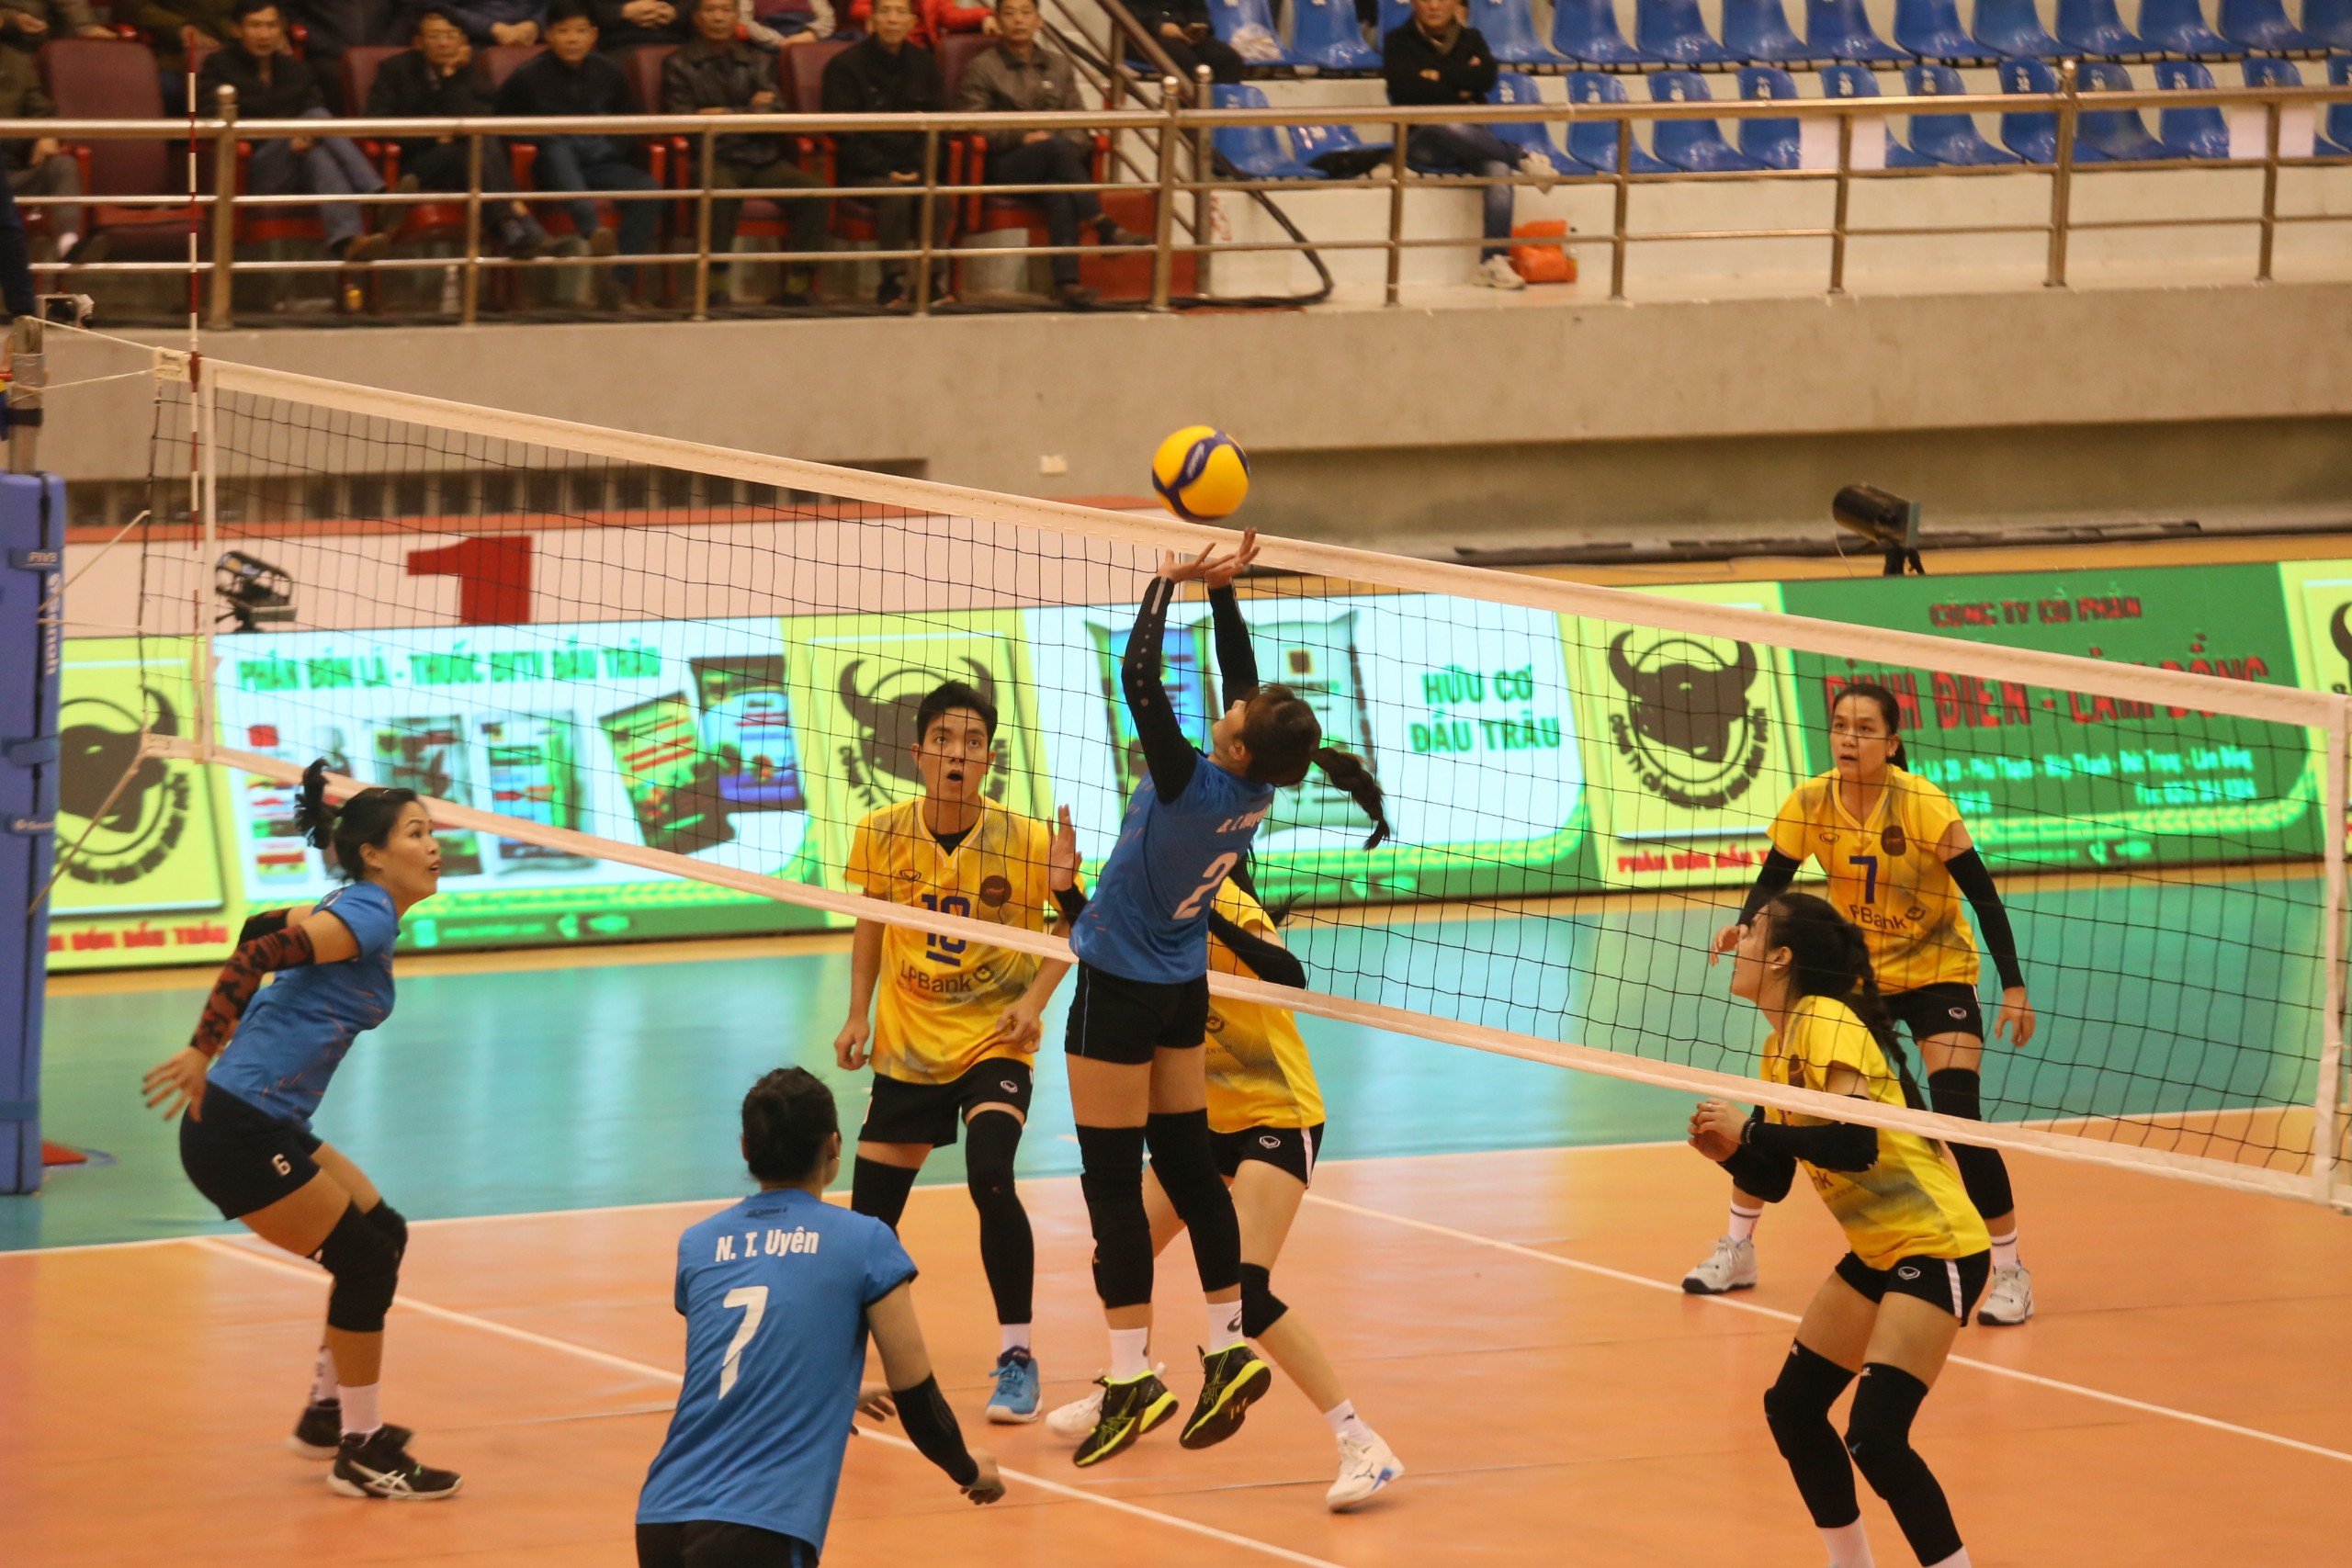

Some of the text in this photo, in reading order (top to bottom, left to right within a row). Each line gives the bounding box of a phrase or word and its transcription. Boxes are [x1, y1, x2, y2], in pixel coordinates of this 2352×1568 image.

[2002, 600, 2030, 625] TY
[1480, 710, 1560, 750] TRÂU
[1172, 852, 1238, 919] 2
[1849, 855, 1878, 904] 7
[1849, 903, 1907, 930] PBank
[900, 959, 972, 993] LPBank
[272, 1153, 291, 1177] 6
[715, 1226, 820, 1262] N. T. Uyên
[718, 1285, 769, 1401] 7
